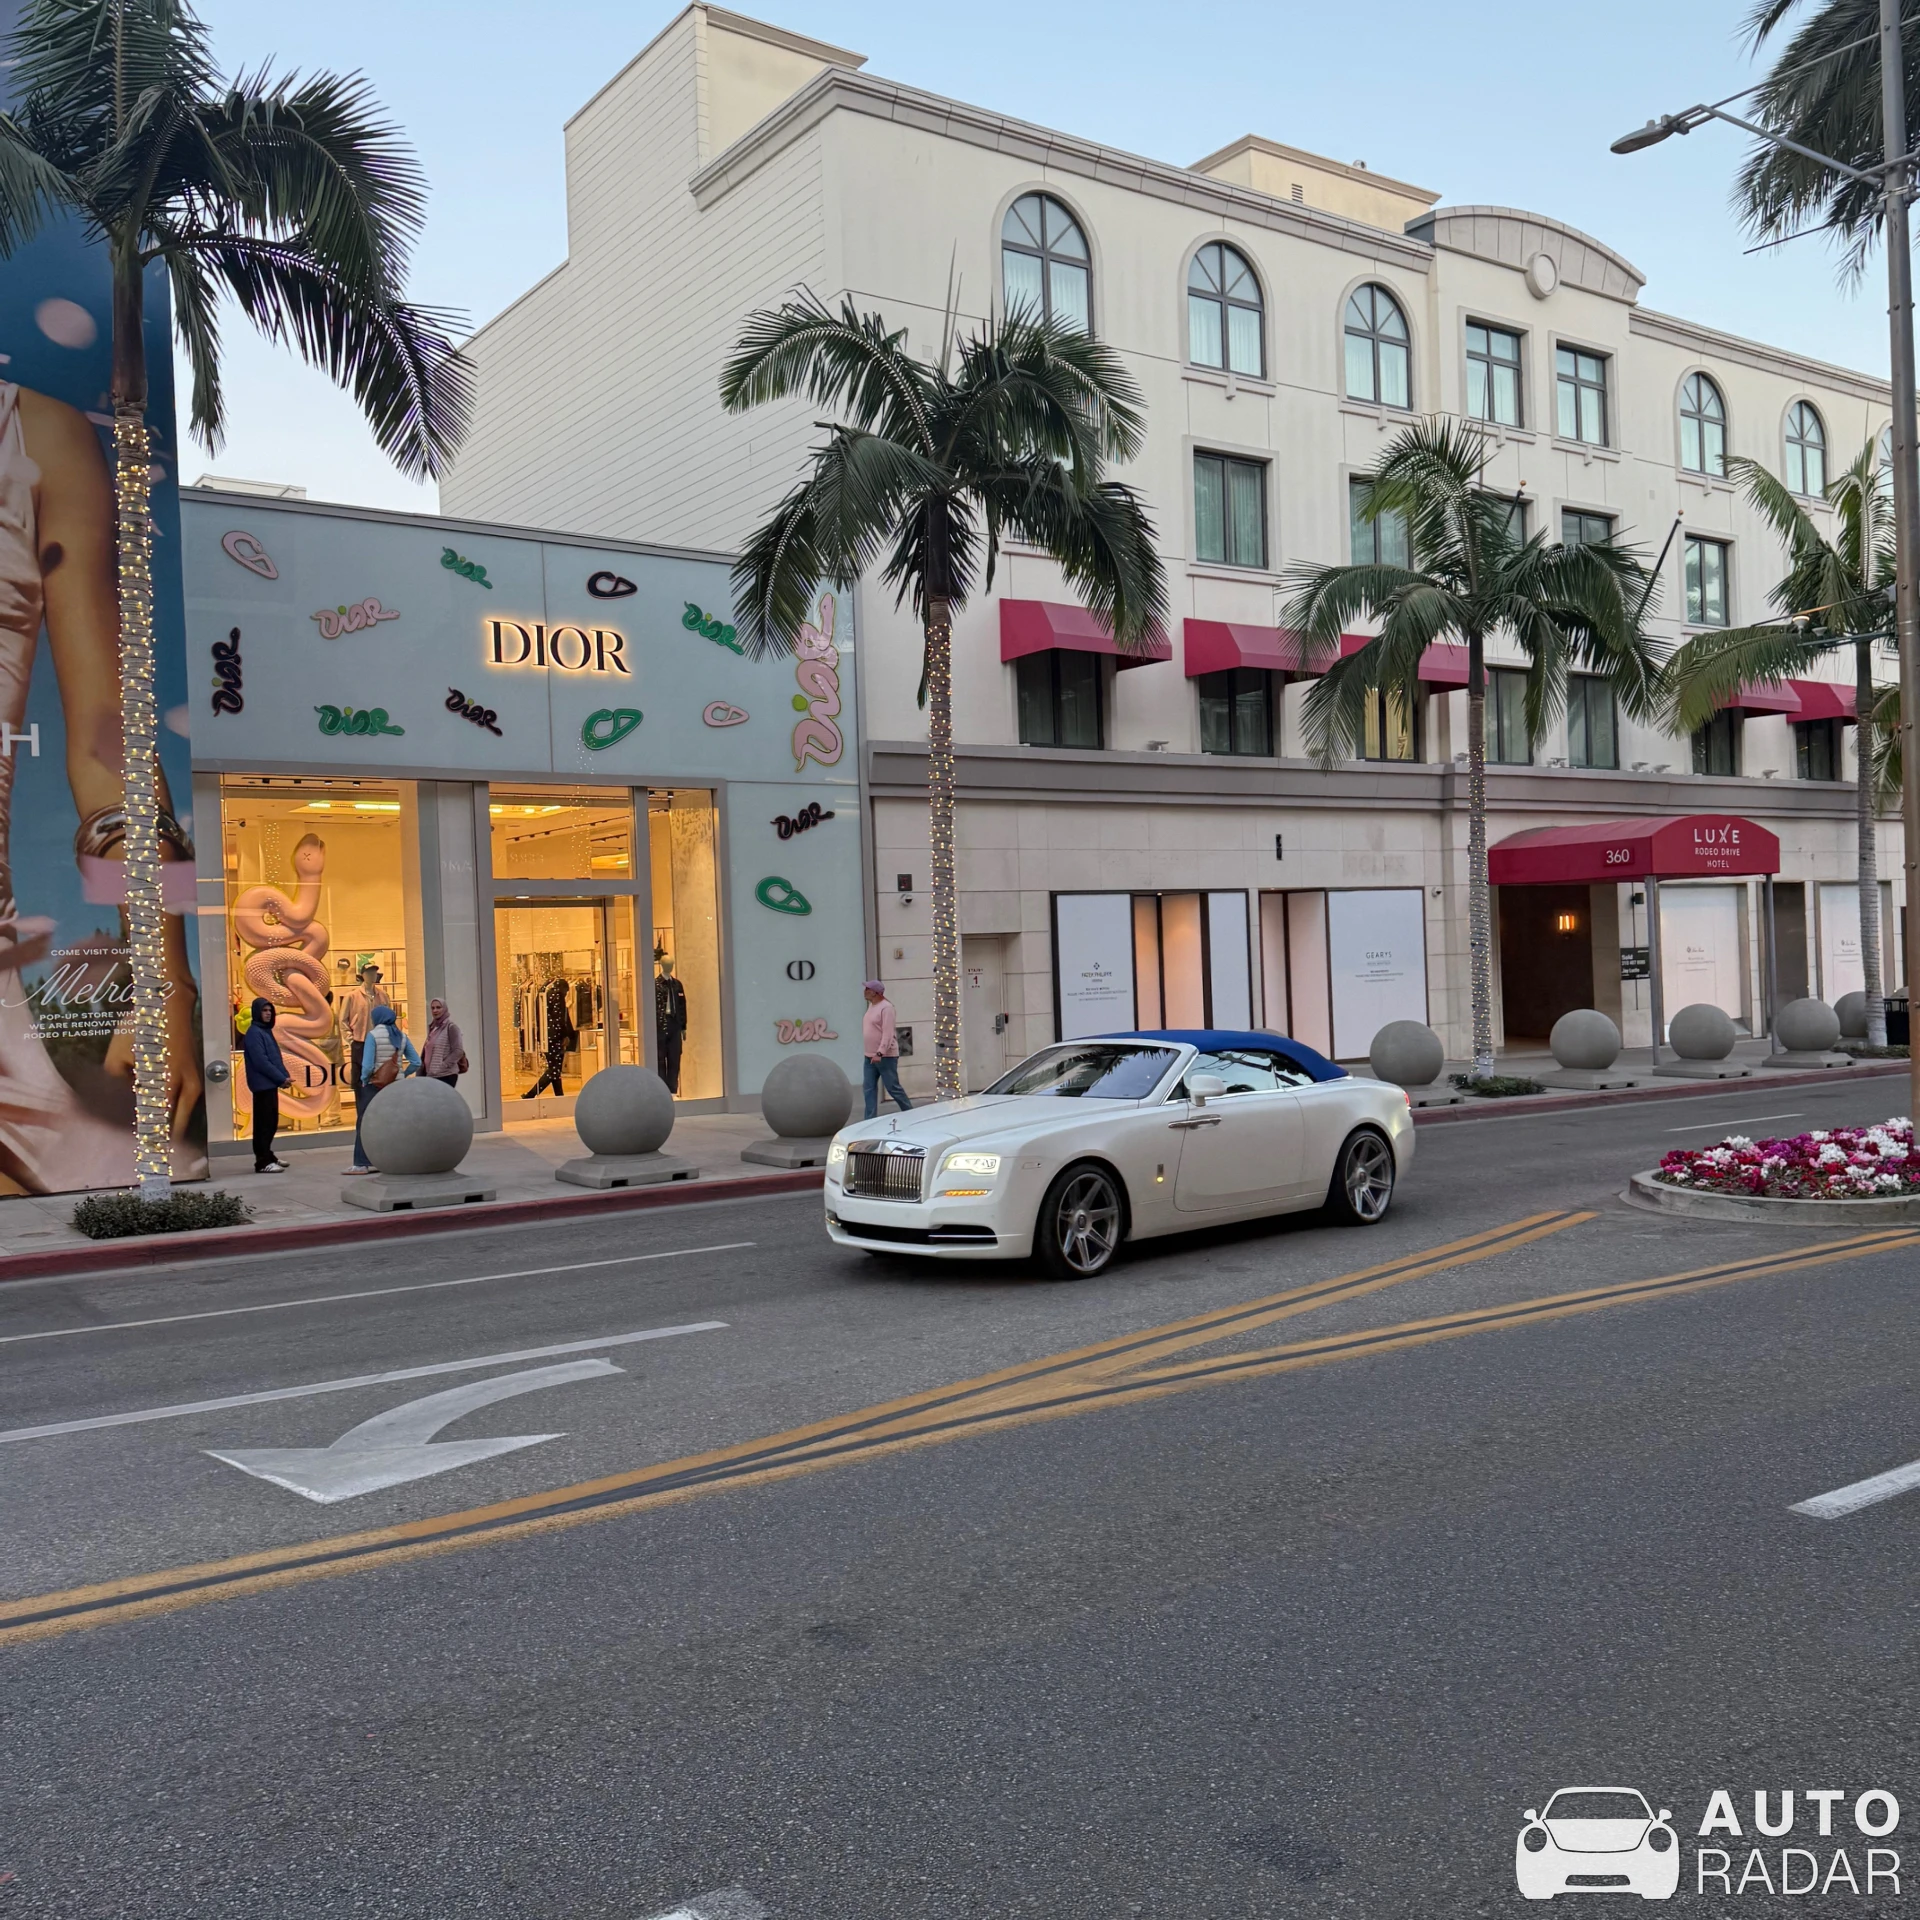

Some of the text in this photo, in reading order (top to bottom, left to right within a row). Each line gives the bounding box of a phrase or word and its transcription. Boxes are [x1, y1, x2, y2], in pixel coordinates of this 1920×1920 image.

[487, 620, 631, 673] DIOR
[1694, 824, 1740, 843] LUXE
[1695, 847, 1740, 856] RODEO DRIVE
[1606, 849, 1630, 864] 360
[1707, 860, 1729, 868] HOTEL
[82, 948, 108, 956] VISIT
[1366, 951, 1392, 959] GEARYS
[1, 962, 176, 1008] Melroe
[39, 1013, 79, 1021] POP-UP
[71, 1019, 135, 1028] RENOVATING
[24, 1031, 60, 1040] RODEO
[62, 1029, 111, 1038] FLAGSHIP
